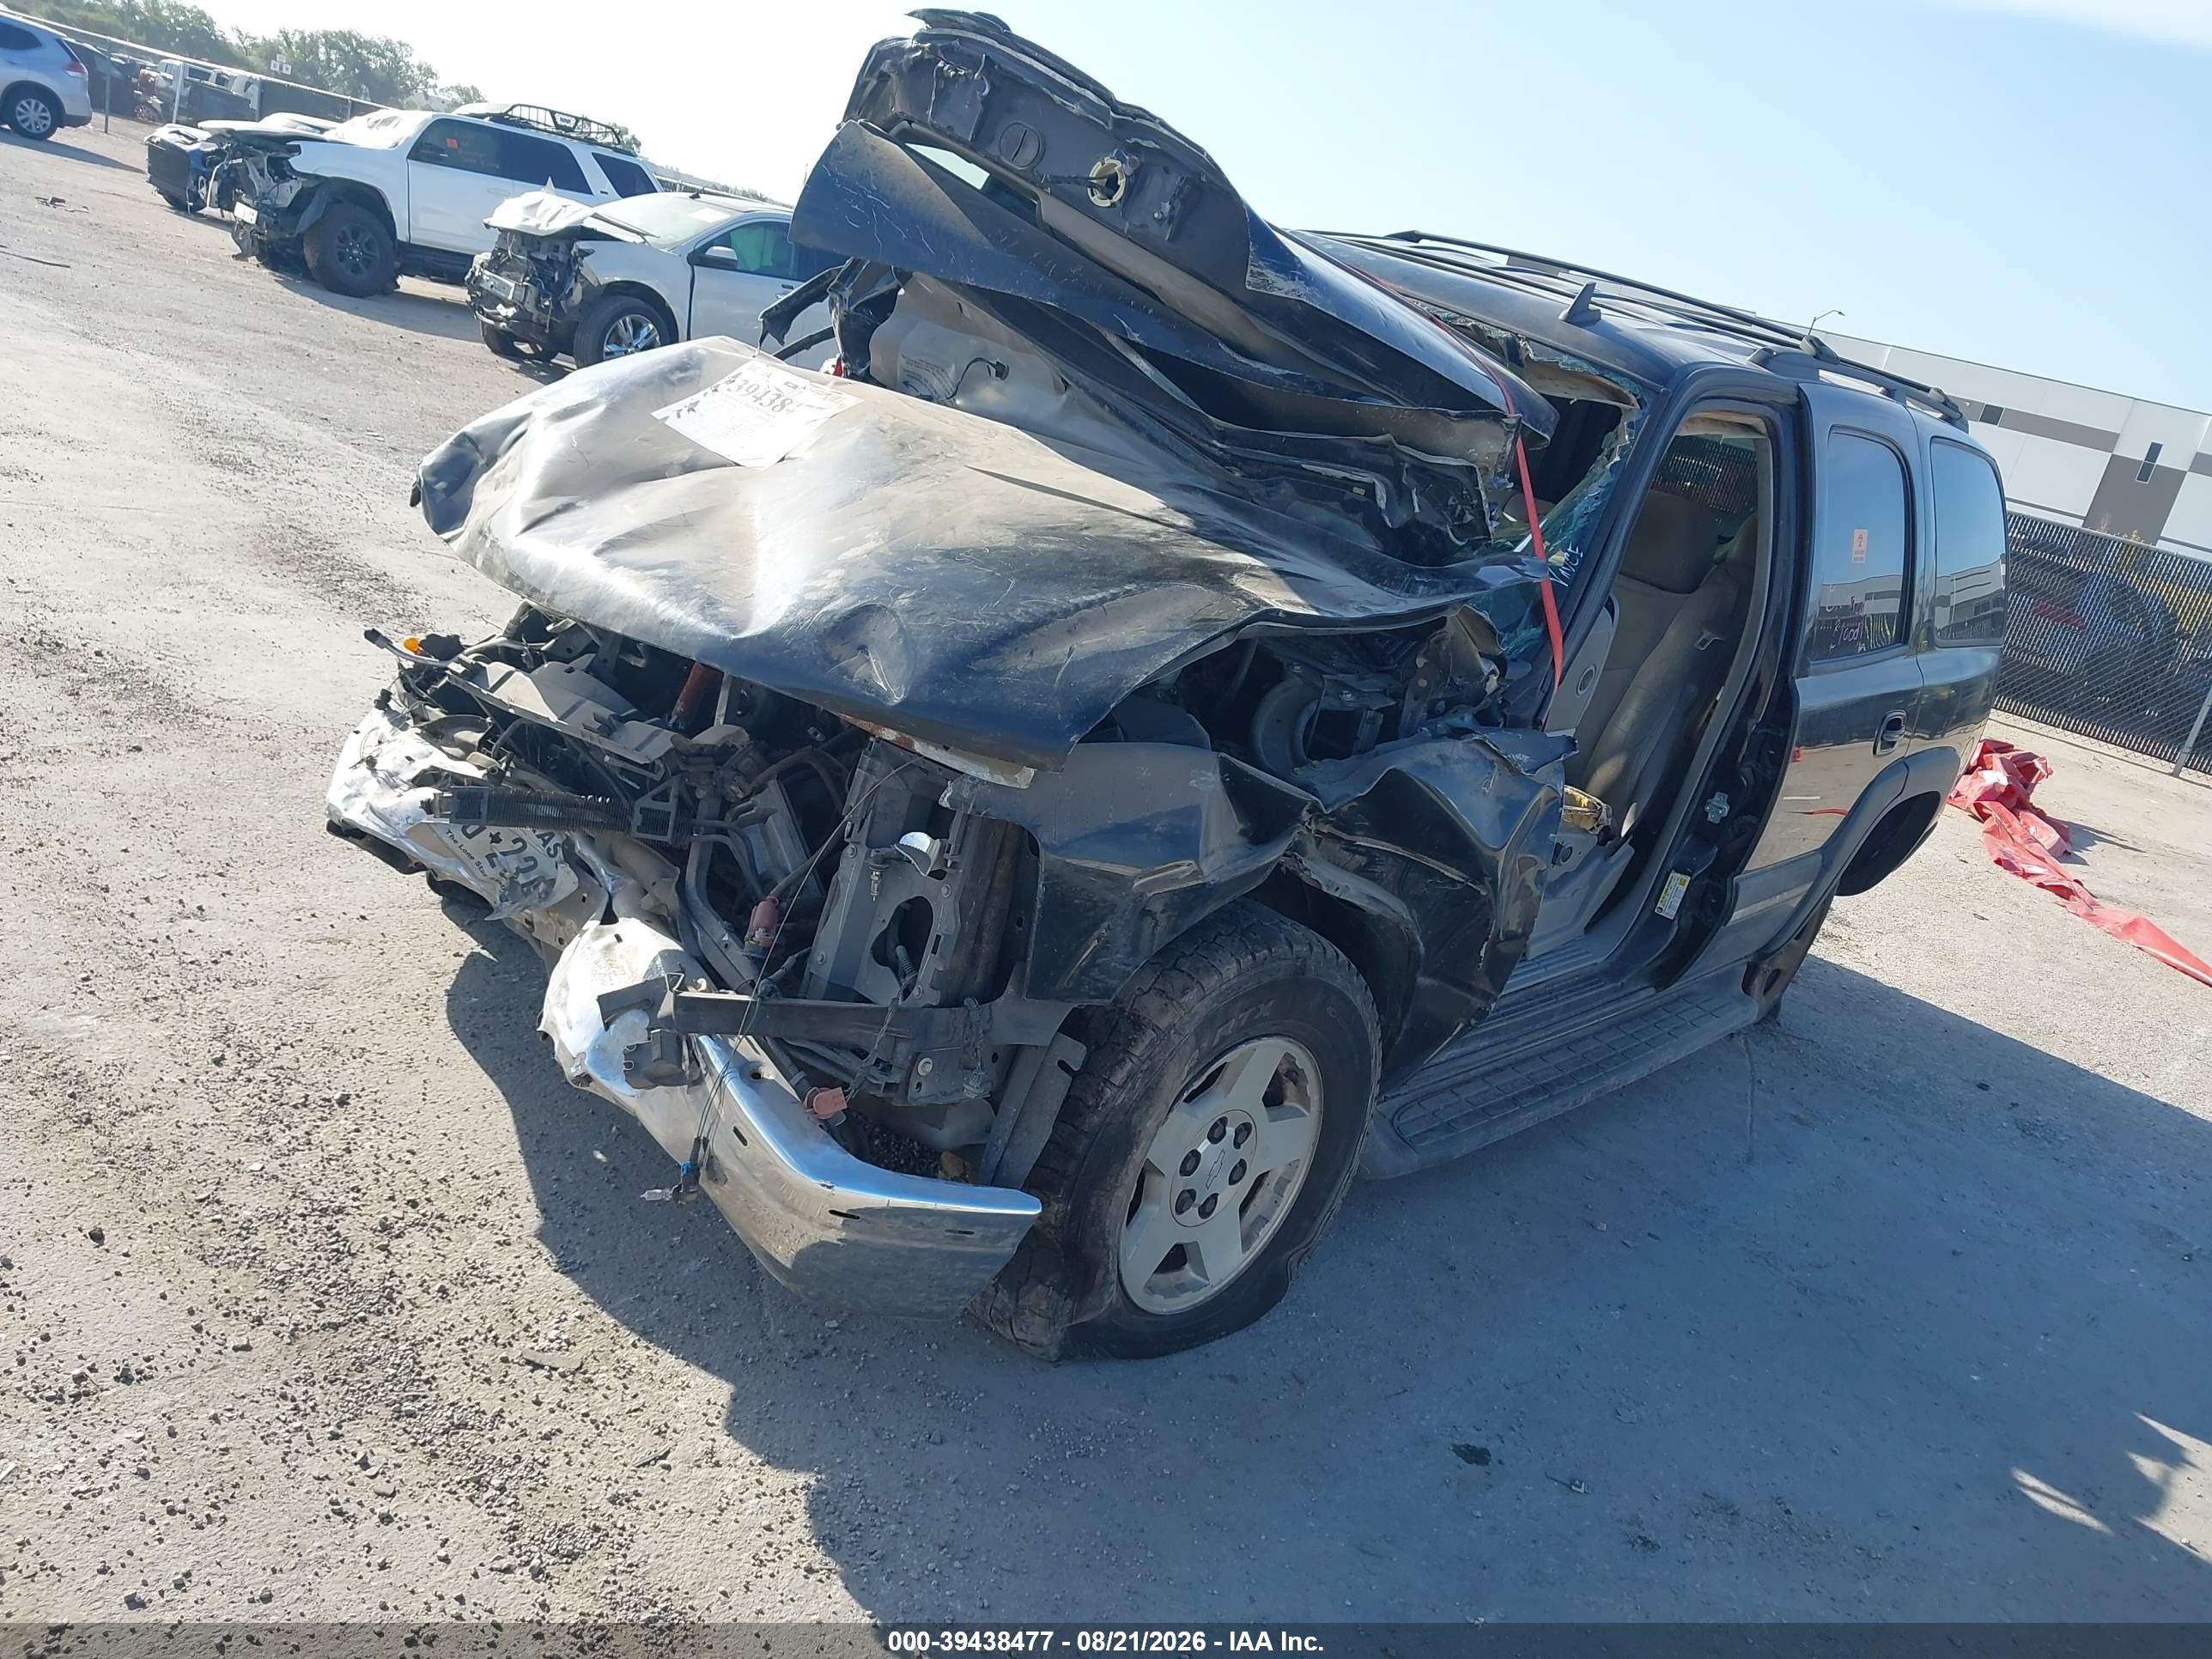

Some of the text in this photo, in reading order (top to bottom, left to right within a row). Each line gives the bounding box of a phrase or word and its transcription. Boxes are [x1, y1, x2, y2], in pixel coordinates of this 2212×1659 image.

[446, 828, 459, 845] The
[458, 844, 475, 860] Lone
[474, 860, 489, 878] Star
